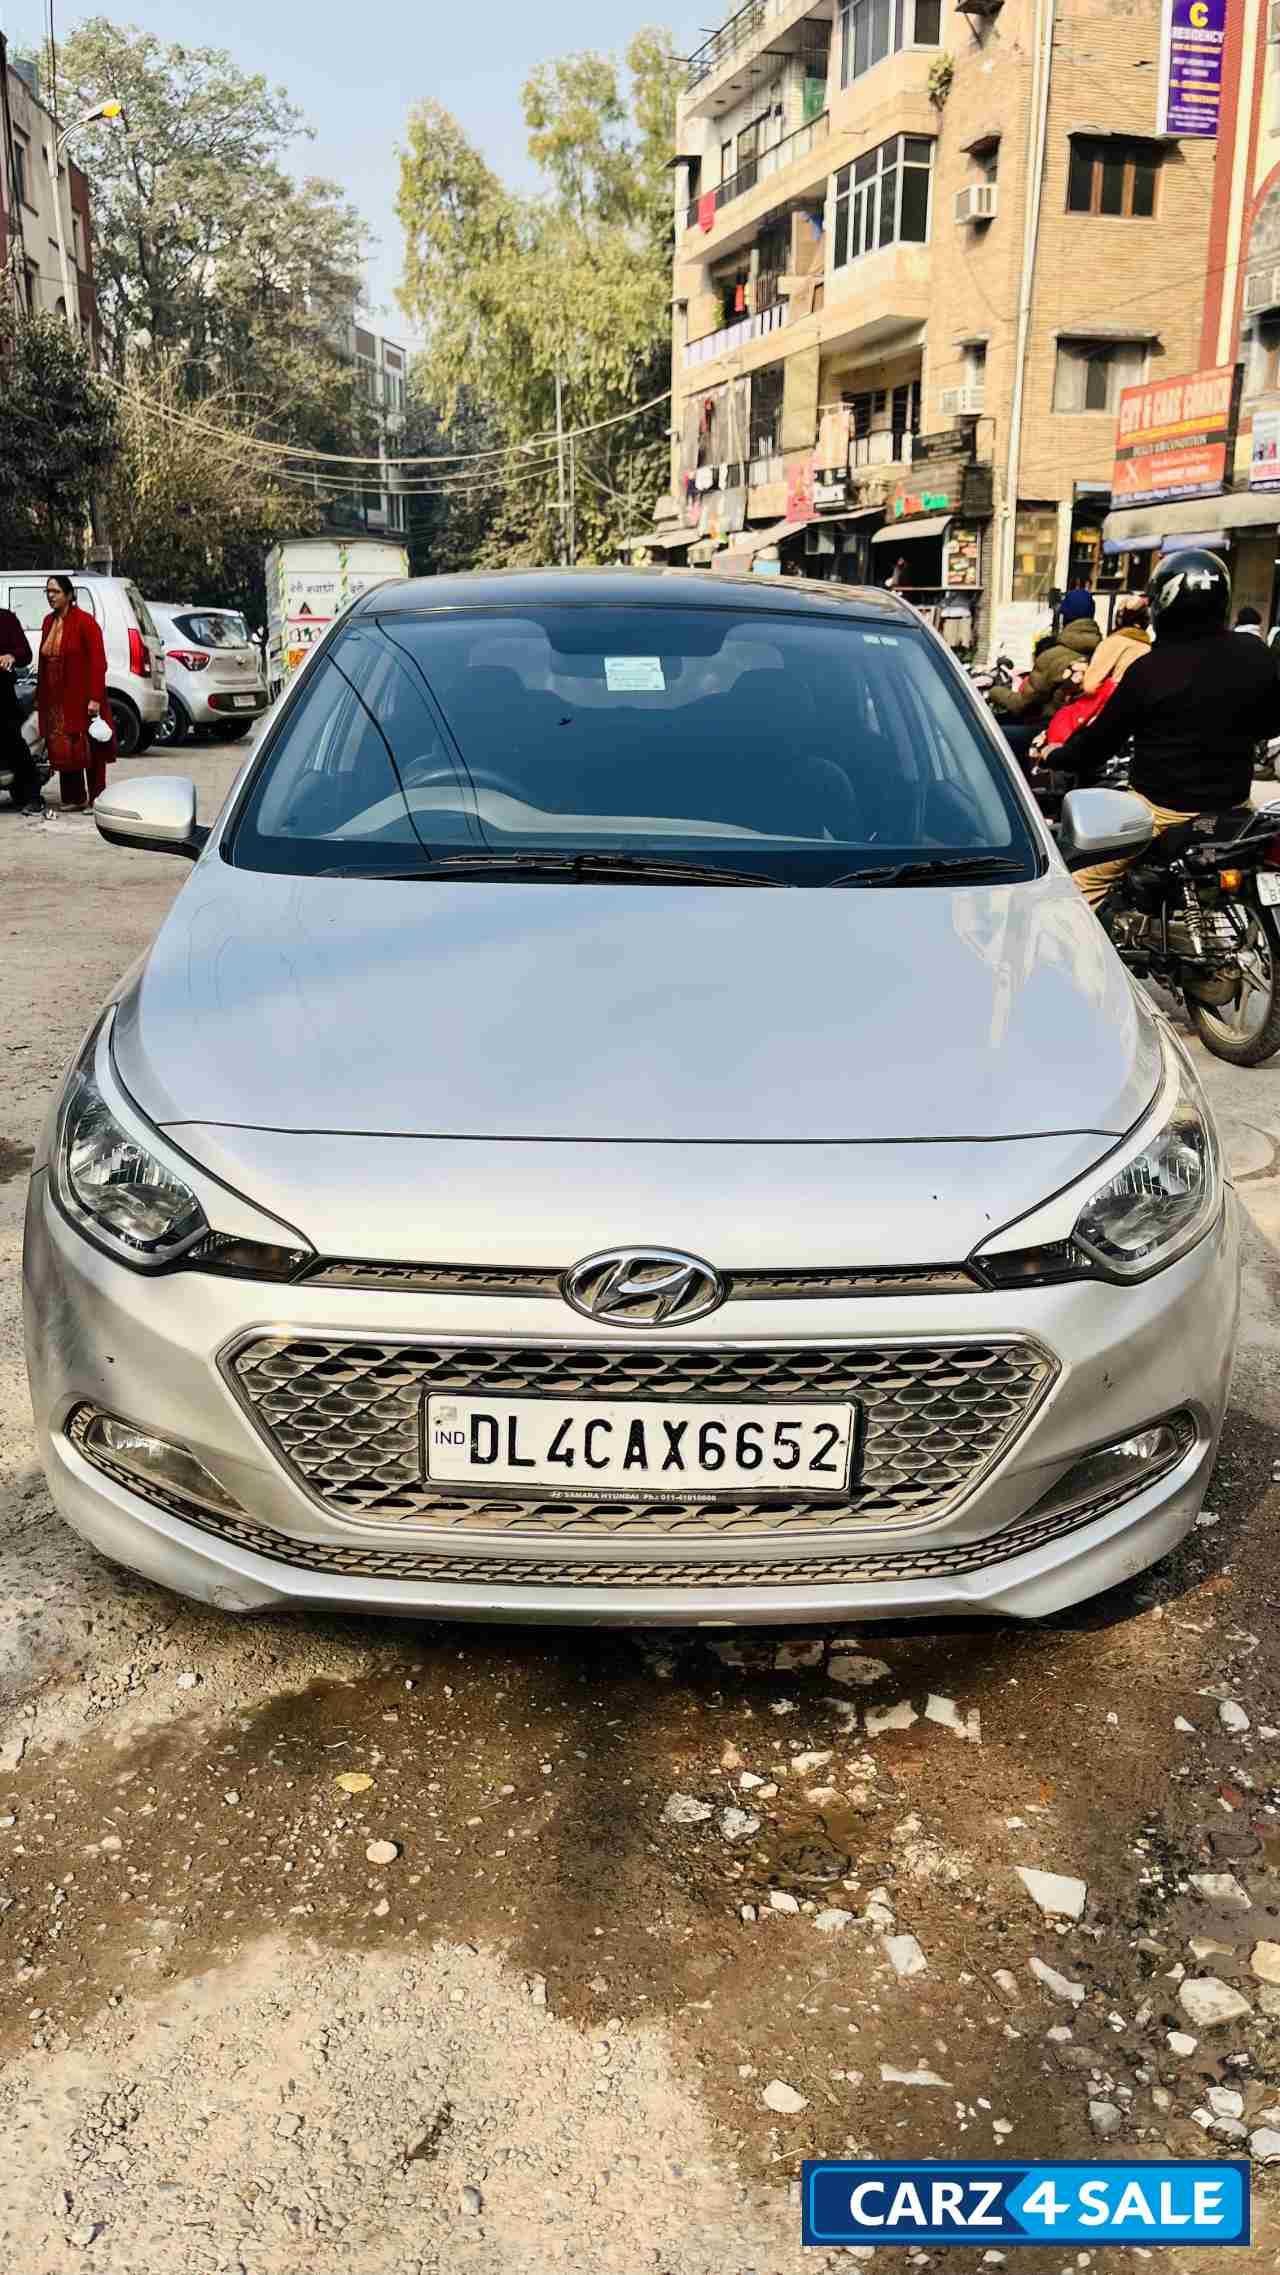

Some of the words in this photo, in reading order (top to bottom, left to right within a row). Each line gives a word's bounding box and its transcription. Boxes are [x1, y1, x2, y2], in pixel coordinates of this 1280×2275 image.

[1189, 2, 1208, 28] C
[434, 1430, 465, 1446] IND
[470, 1414, 841, 1472] DL4CAX6652
